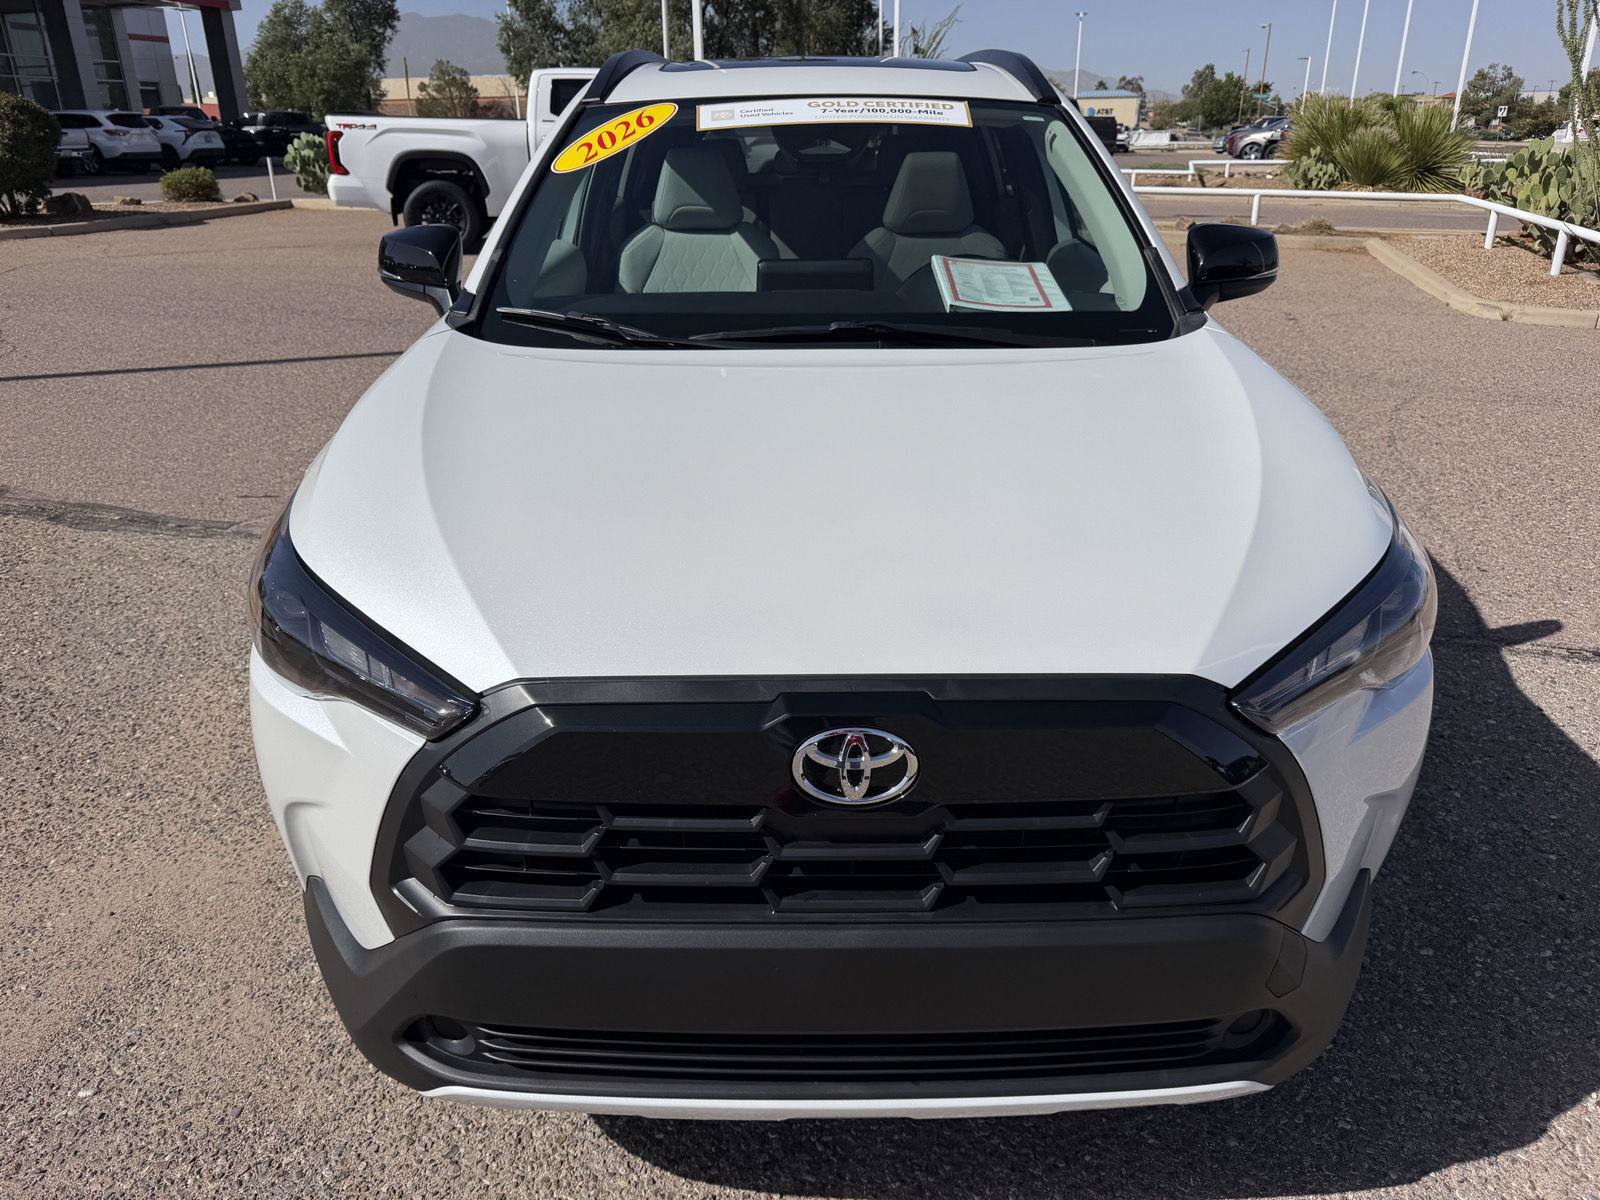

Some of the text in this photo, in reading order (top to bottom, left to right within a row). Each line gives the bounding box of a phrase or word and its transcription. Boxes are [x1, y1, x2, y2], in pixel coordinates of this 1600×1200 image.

[863, 101, 954, 111] CERTIFIED
[821, 108, 944, 116] 7-Year/100,000-Mile
[576, 109, 655, 164] 2026
